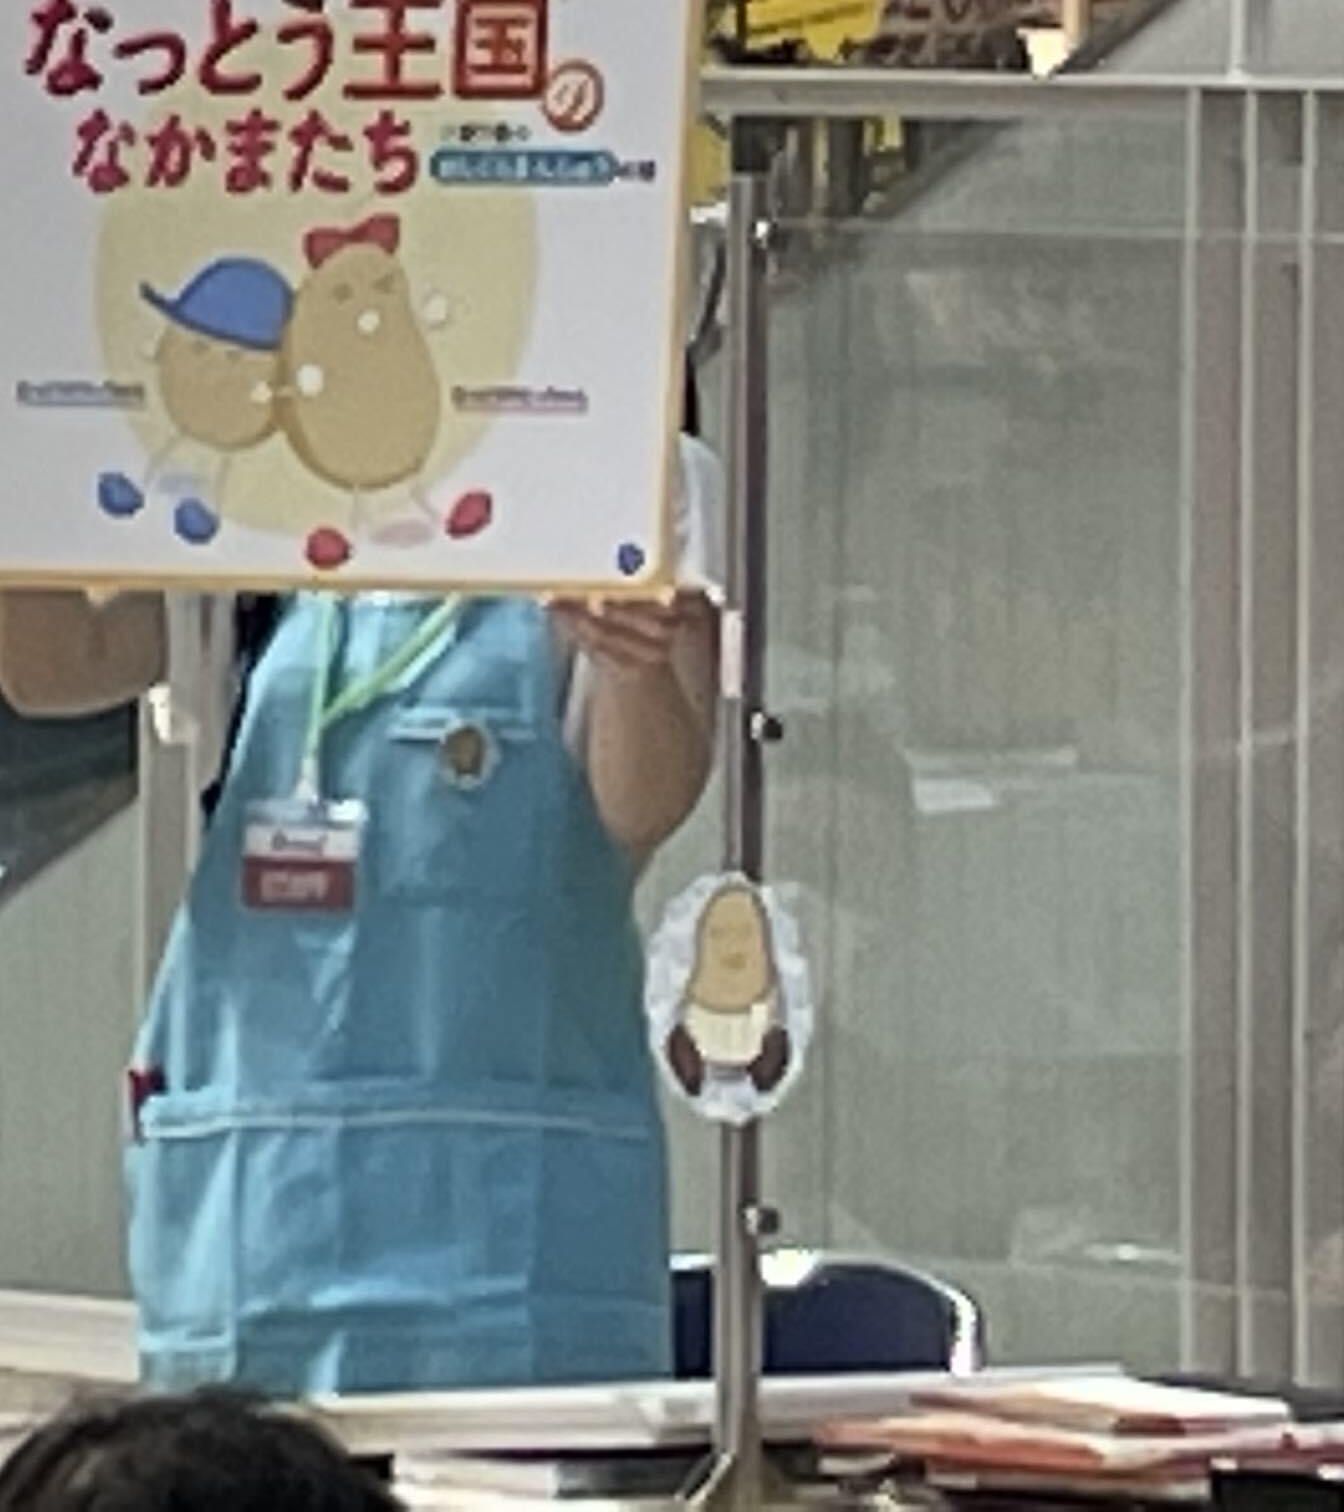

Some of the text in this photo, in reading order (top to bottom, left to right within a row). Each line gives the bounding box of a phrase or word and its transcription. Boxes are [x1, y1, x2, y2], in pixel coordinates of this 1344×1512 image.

[72, 108, 420, 194] なかまたち
